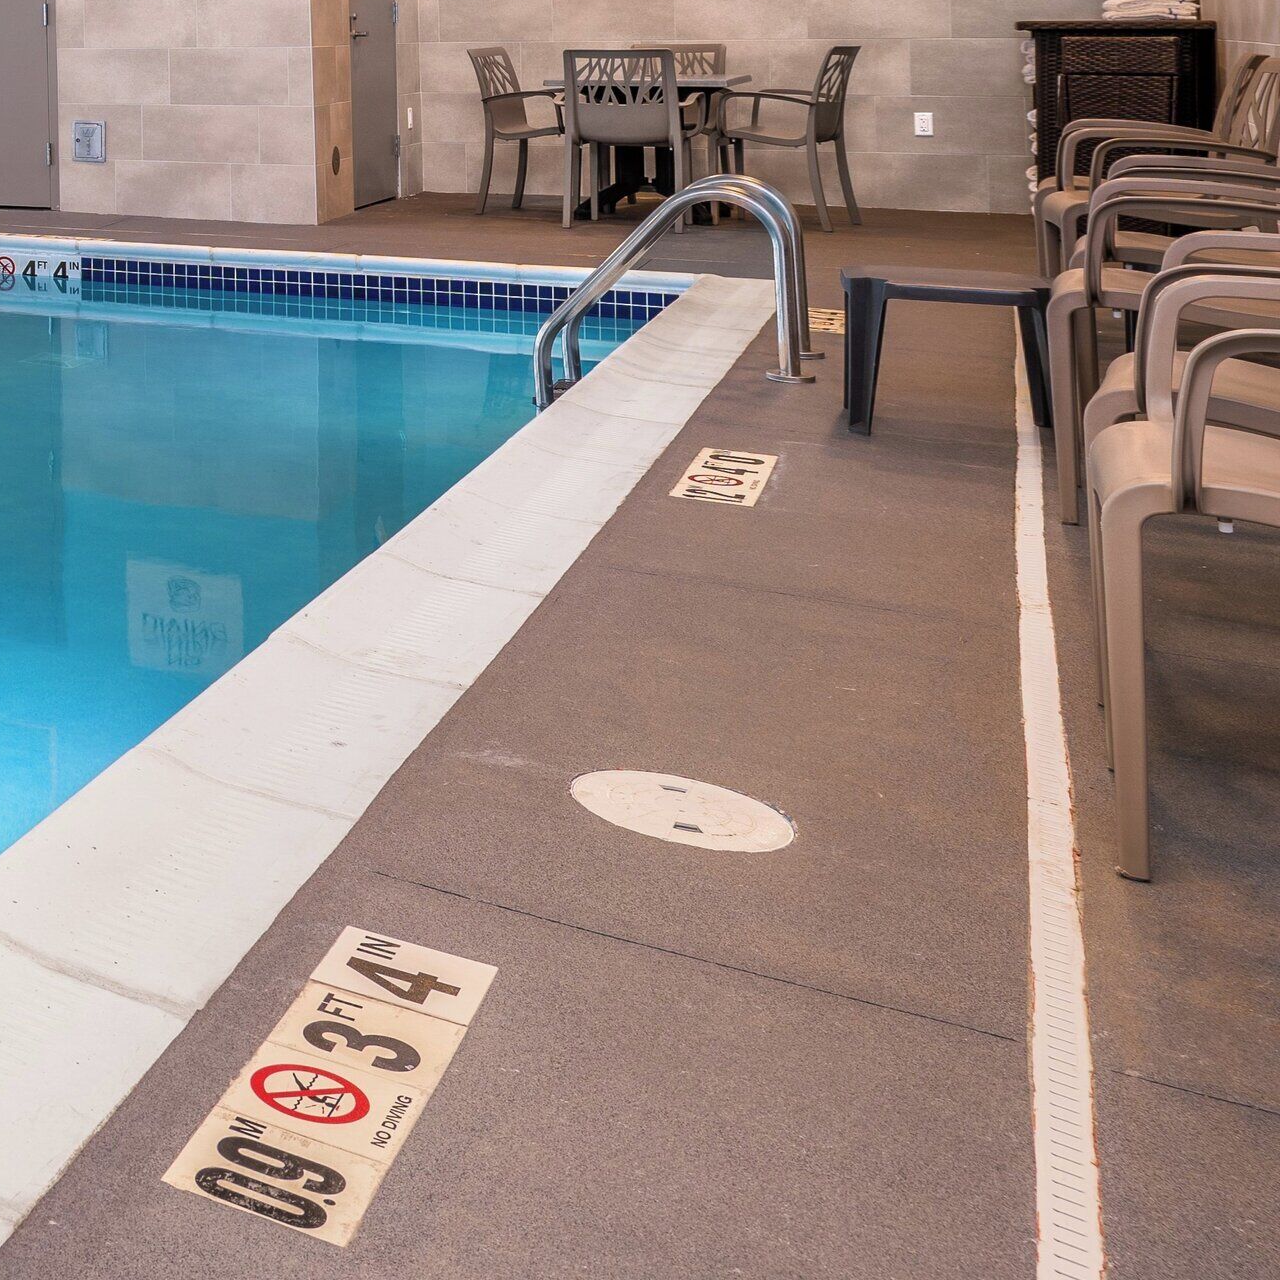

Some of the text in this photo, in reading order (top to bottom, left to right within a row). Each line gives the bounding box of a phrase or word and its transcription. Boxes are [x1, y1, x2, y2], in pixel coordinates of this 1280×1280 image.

[37, 261, 48, 270] FT
[69, 261, 80, 271] IN
[355, 934, 402, 961] IN
[345, 955, 462, 1006] 4
[316, 992, 364, 1022] FT
[302, 1019, 422, 1072] 3
[229, 1116, 268, 1139] M
[370, 1094, 414, 1149] NO DIVING
